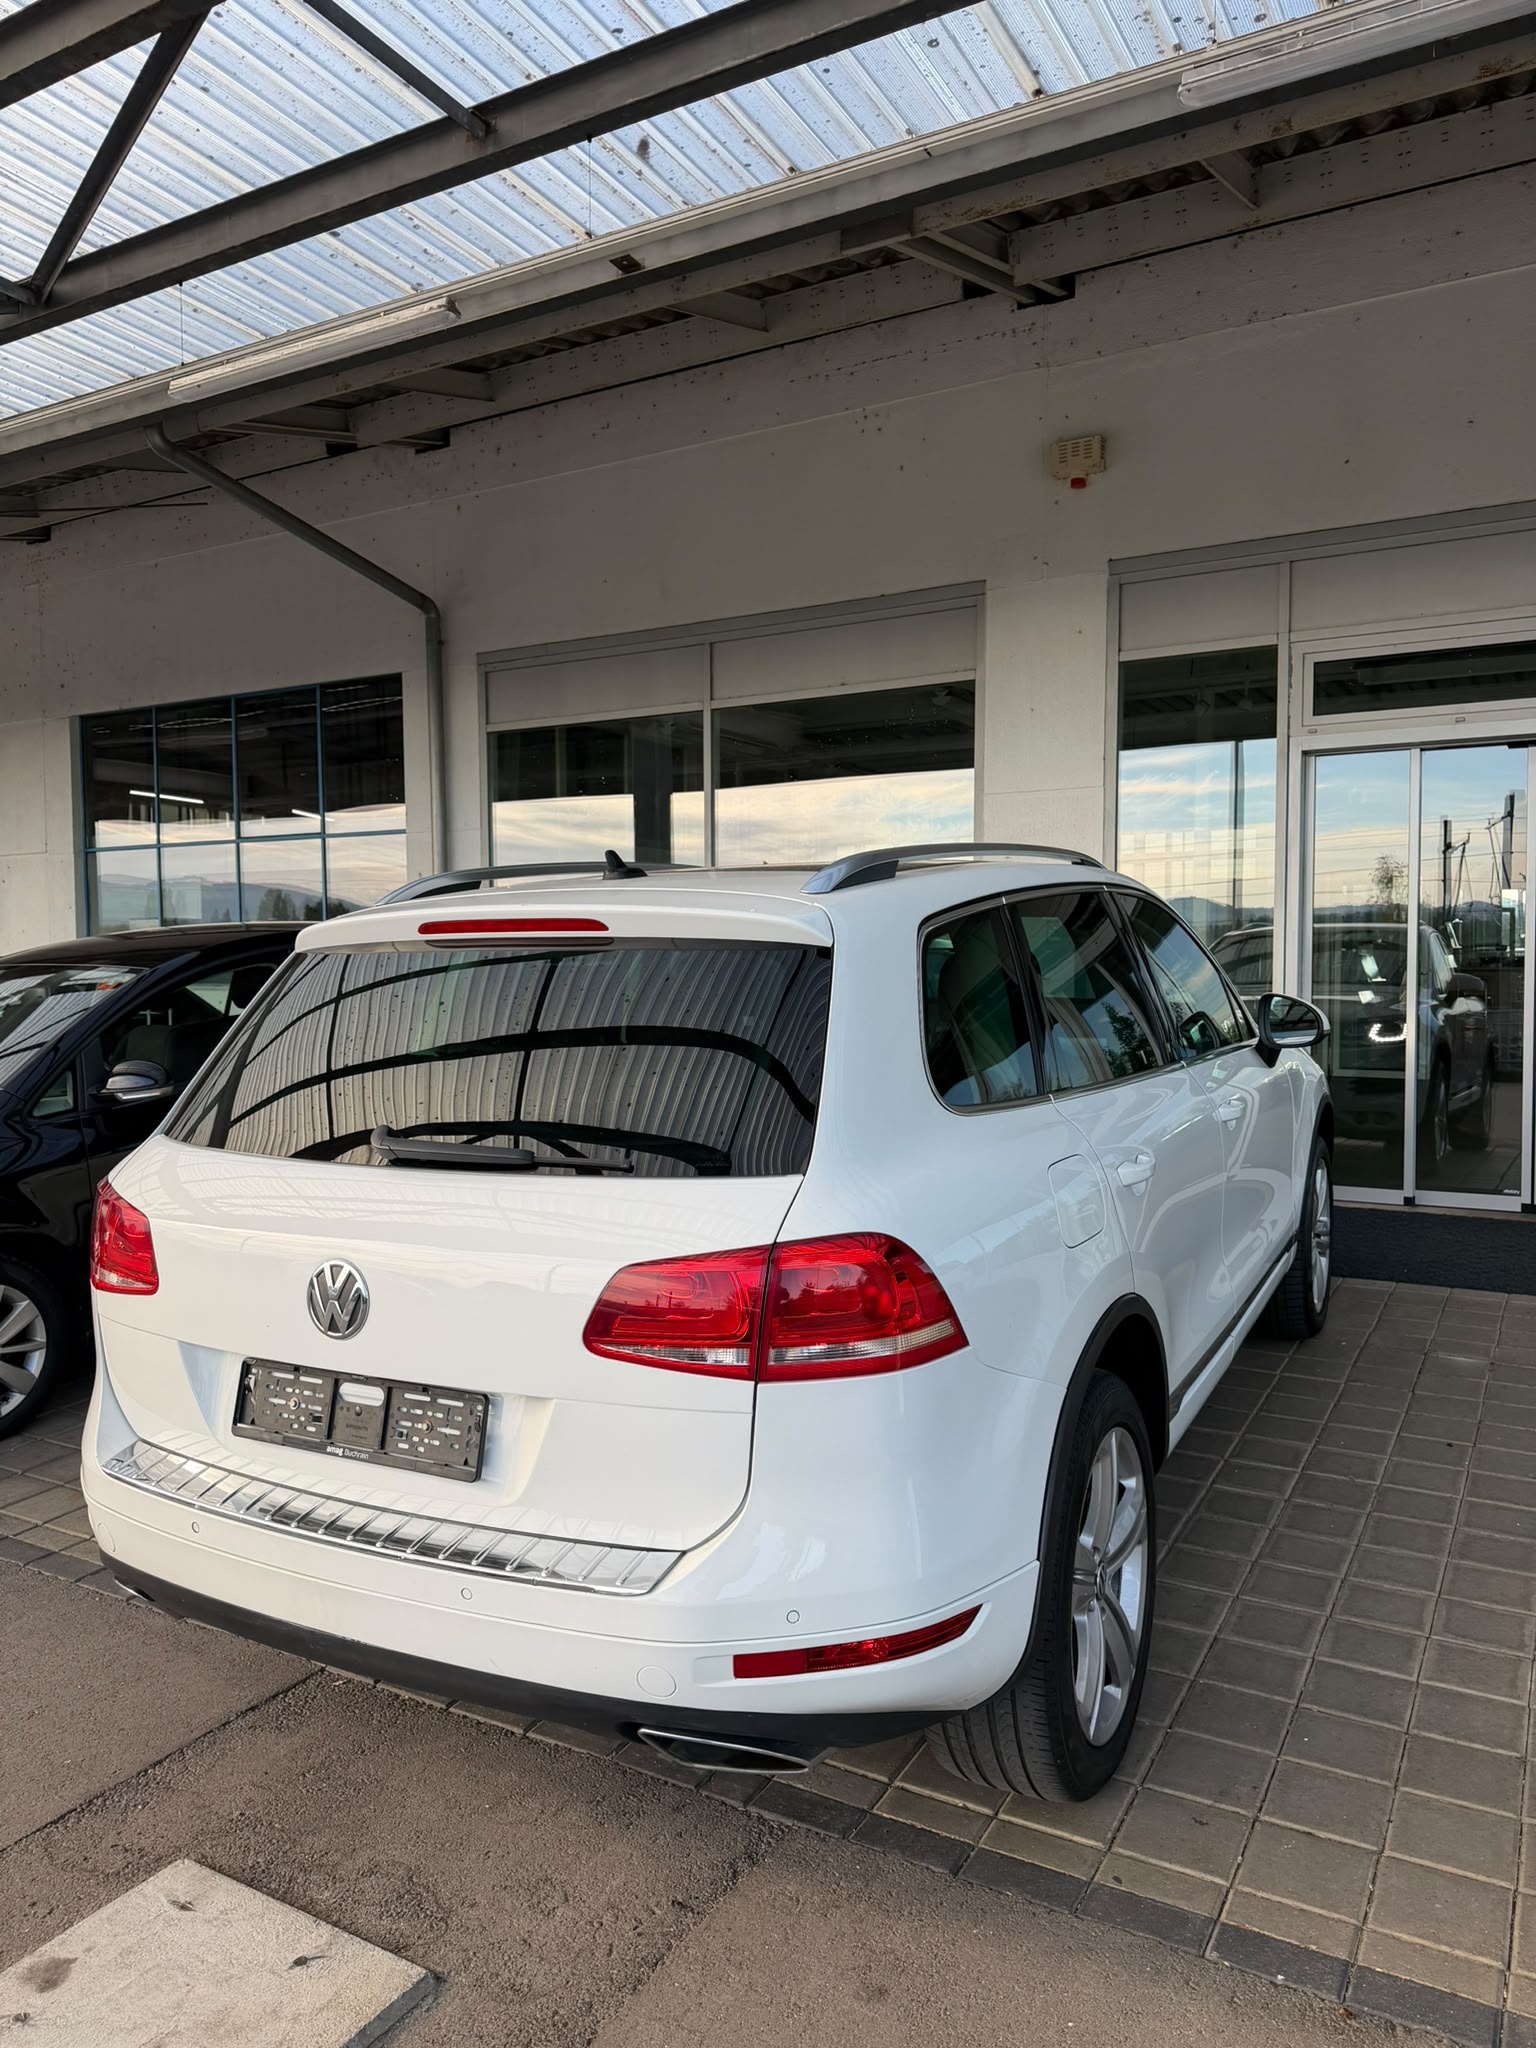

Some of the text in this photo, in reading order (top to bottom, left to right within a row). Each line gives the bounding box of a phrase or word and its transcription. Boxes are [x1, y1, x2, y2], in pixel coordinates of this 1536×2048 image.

[309, 1259, 366, 1335] VW
[327, 1446, 369, 1459] amag Buchrain
